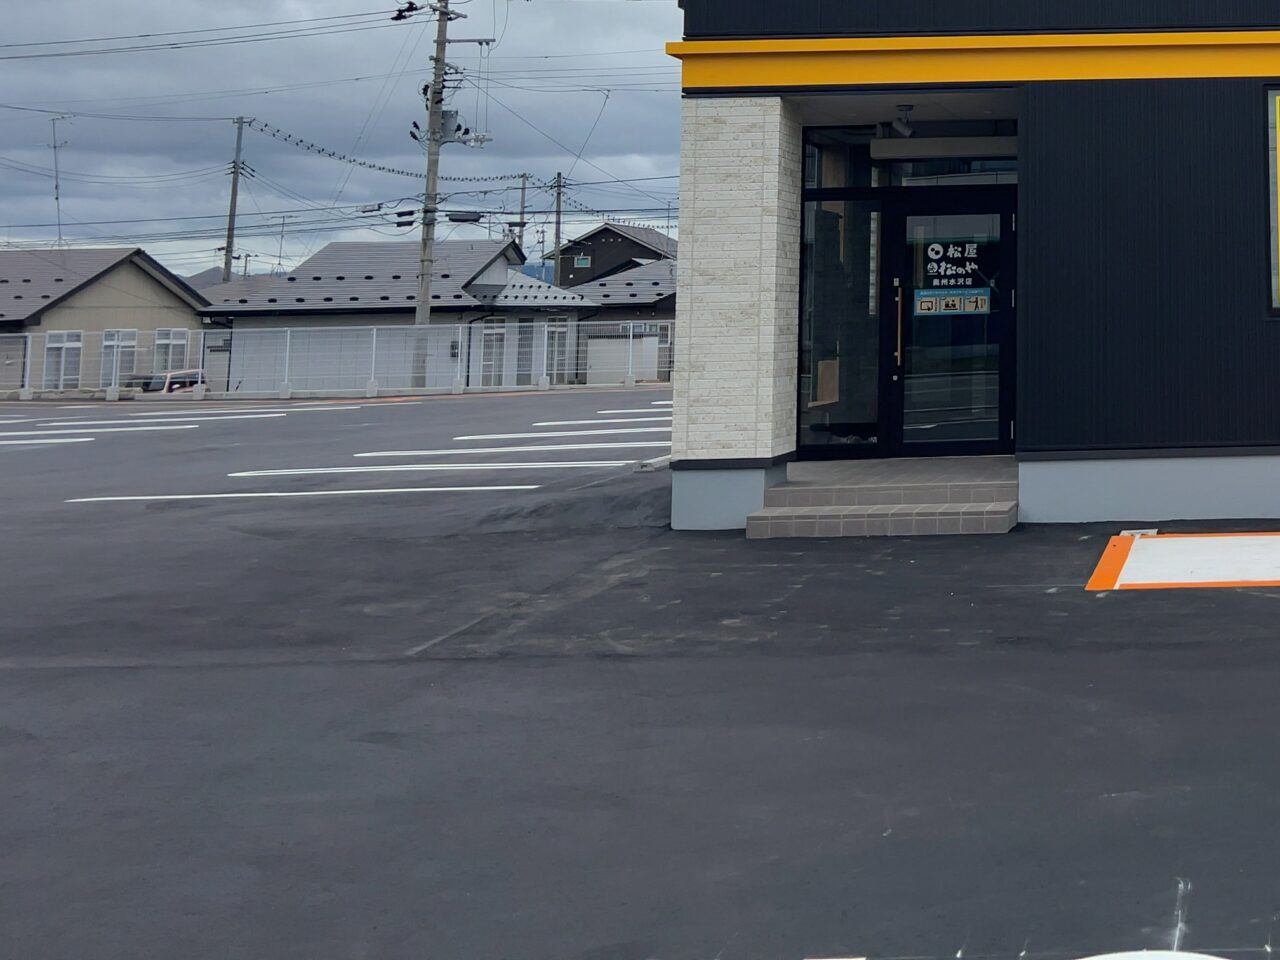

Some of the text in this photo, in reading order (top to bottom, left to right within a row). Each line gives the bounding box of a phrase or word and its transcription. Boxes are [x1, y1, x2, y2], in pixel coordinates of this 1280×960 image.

[946, 243, 978, 258] 松屋
[938, 261, 978, 275] 松のや
